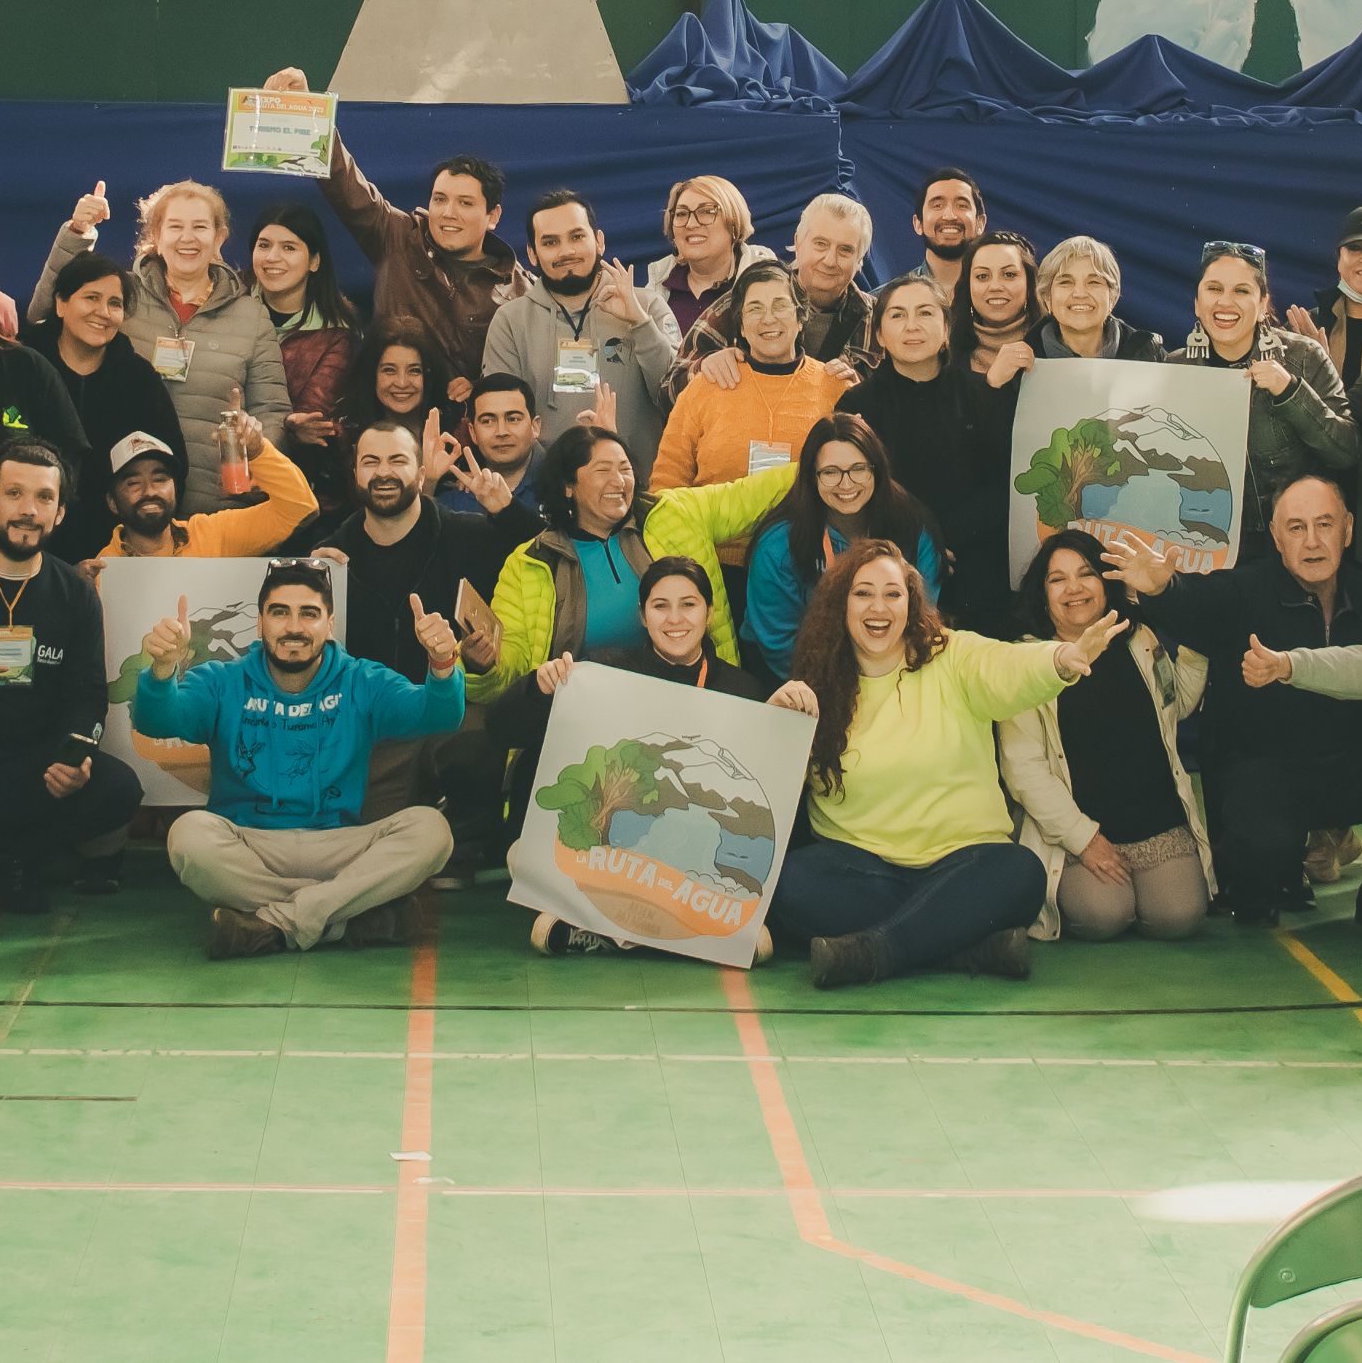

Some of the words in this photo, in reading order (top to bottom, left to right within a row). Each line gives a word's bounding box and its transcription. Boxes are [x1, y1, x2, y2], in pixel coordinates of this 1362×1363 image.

[249, 125, 282, 134] TRISMO
[37, 644, 63, 660] GALA
[589, 846, 658, 889] RUTA
[672, 878, 743, 926] AGUA
